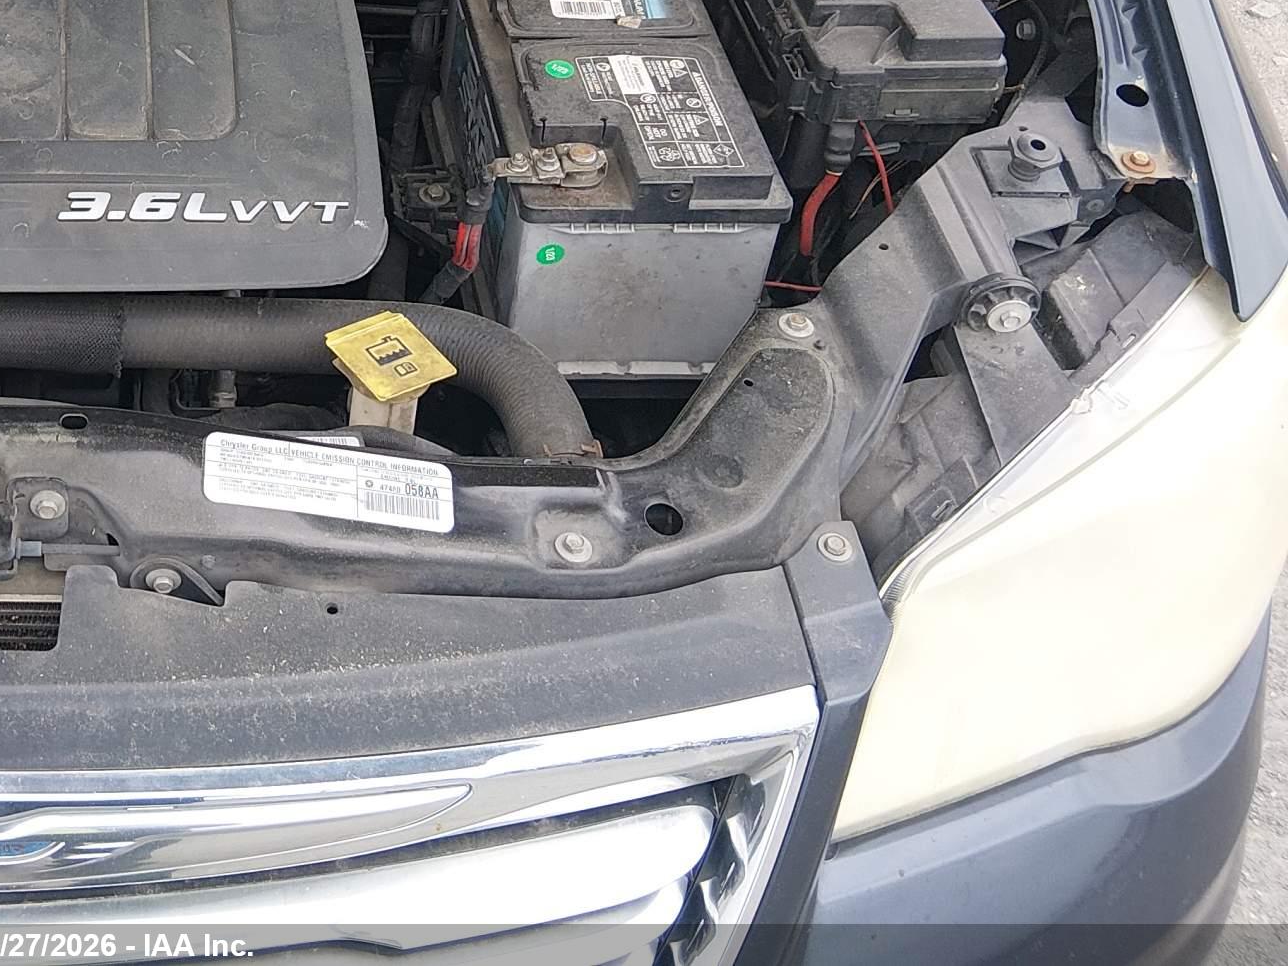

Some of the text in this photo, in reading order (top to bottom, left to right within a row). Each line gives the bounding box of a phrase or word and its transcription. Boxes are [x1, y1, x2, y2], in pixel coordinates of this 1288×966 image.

[220, 438, 288, 455] Chrysler Group LLC
[291, 448, 320, 460] VEHICLE
[321, 452, 355, 465] EMISSION
[356, 457, 388, 470] CONTROL
[390, 461, 440, 476] INFORMATION
[404, 483, 440, 500] 058AA
